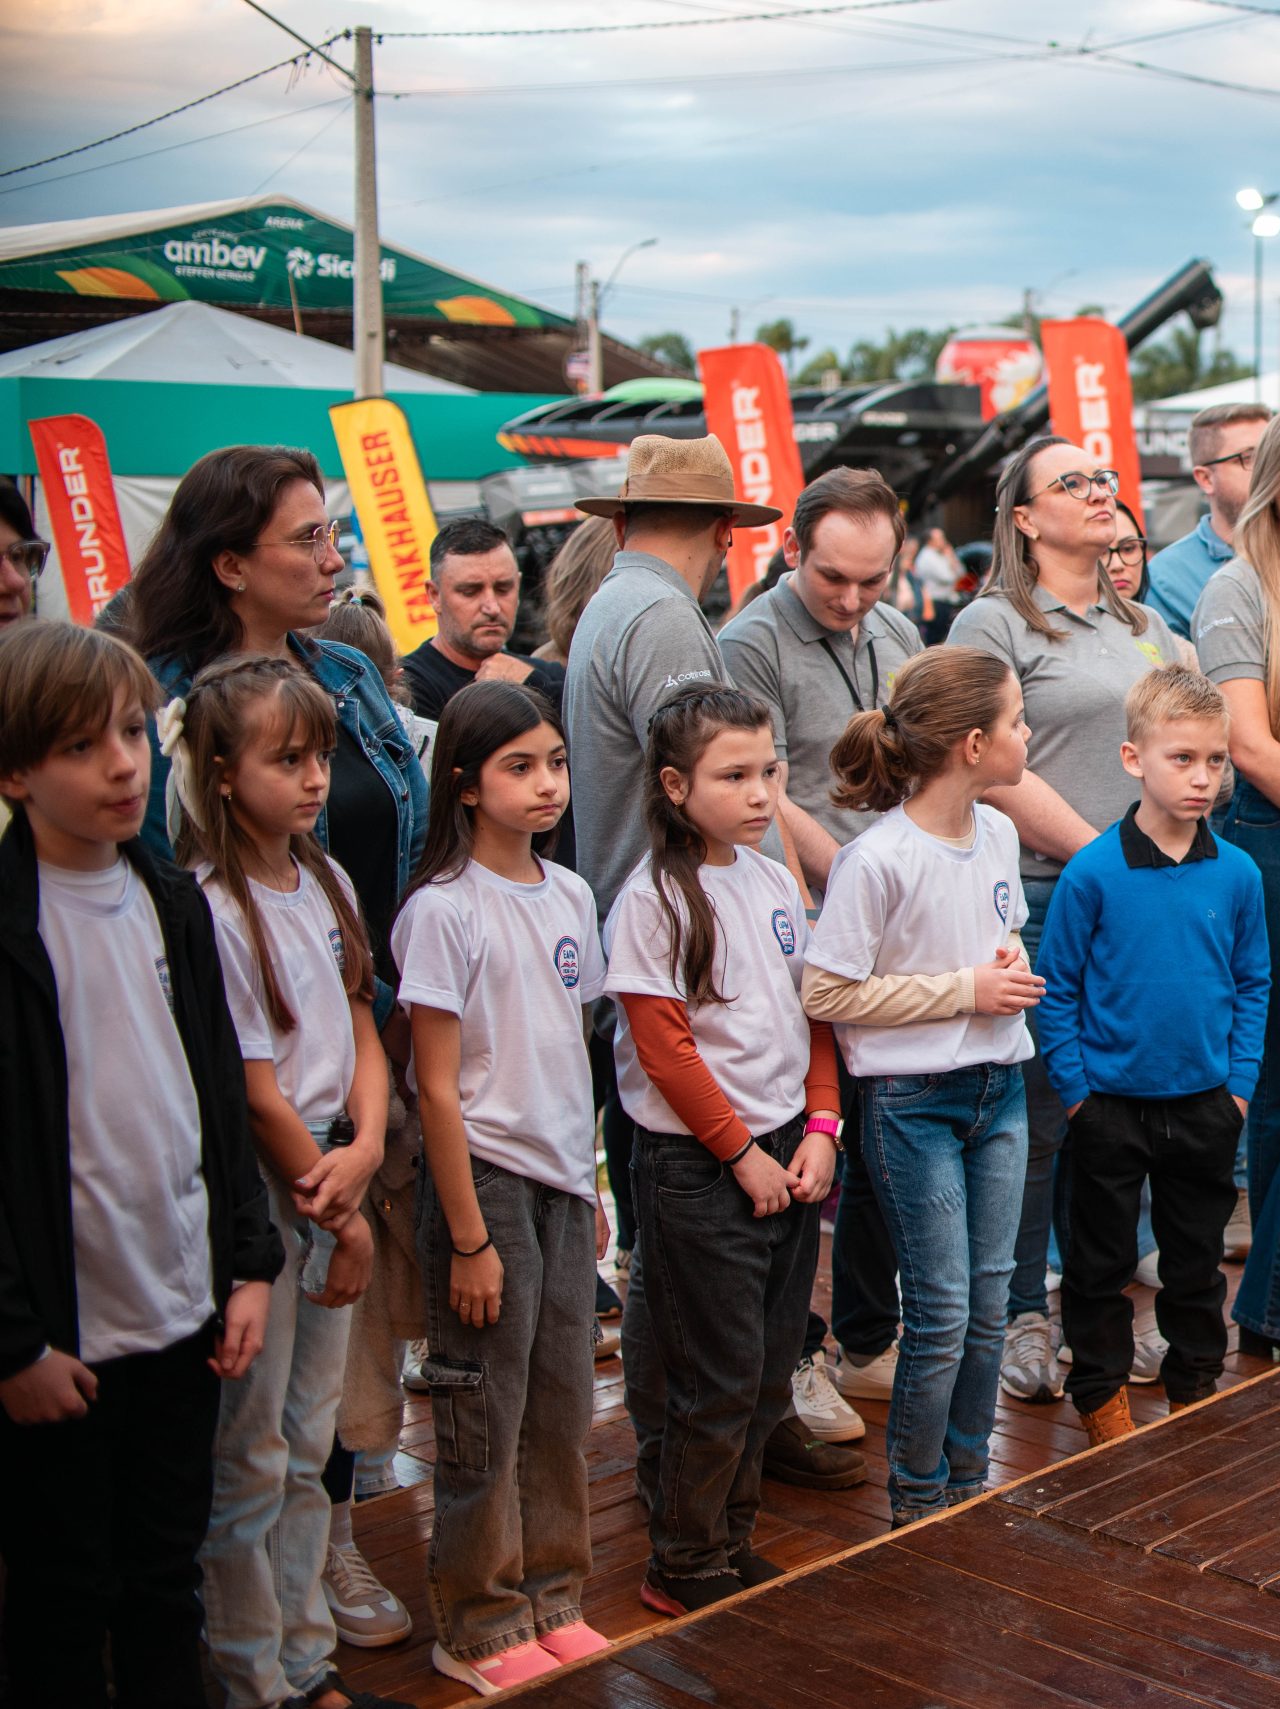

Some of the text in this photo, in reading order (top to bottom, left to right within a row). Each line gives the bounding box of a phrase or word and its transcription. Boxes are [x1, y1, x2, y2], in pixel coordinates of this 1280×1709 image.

[164, 238, 267, 269] ambev
[264, 216, 304, 231] ARENA
[361, 430, 437, 628] FANKHAUSER
[732, 387, 779, 581] UNDER
